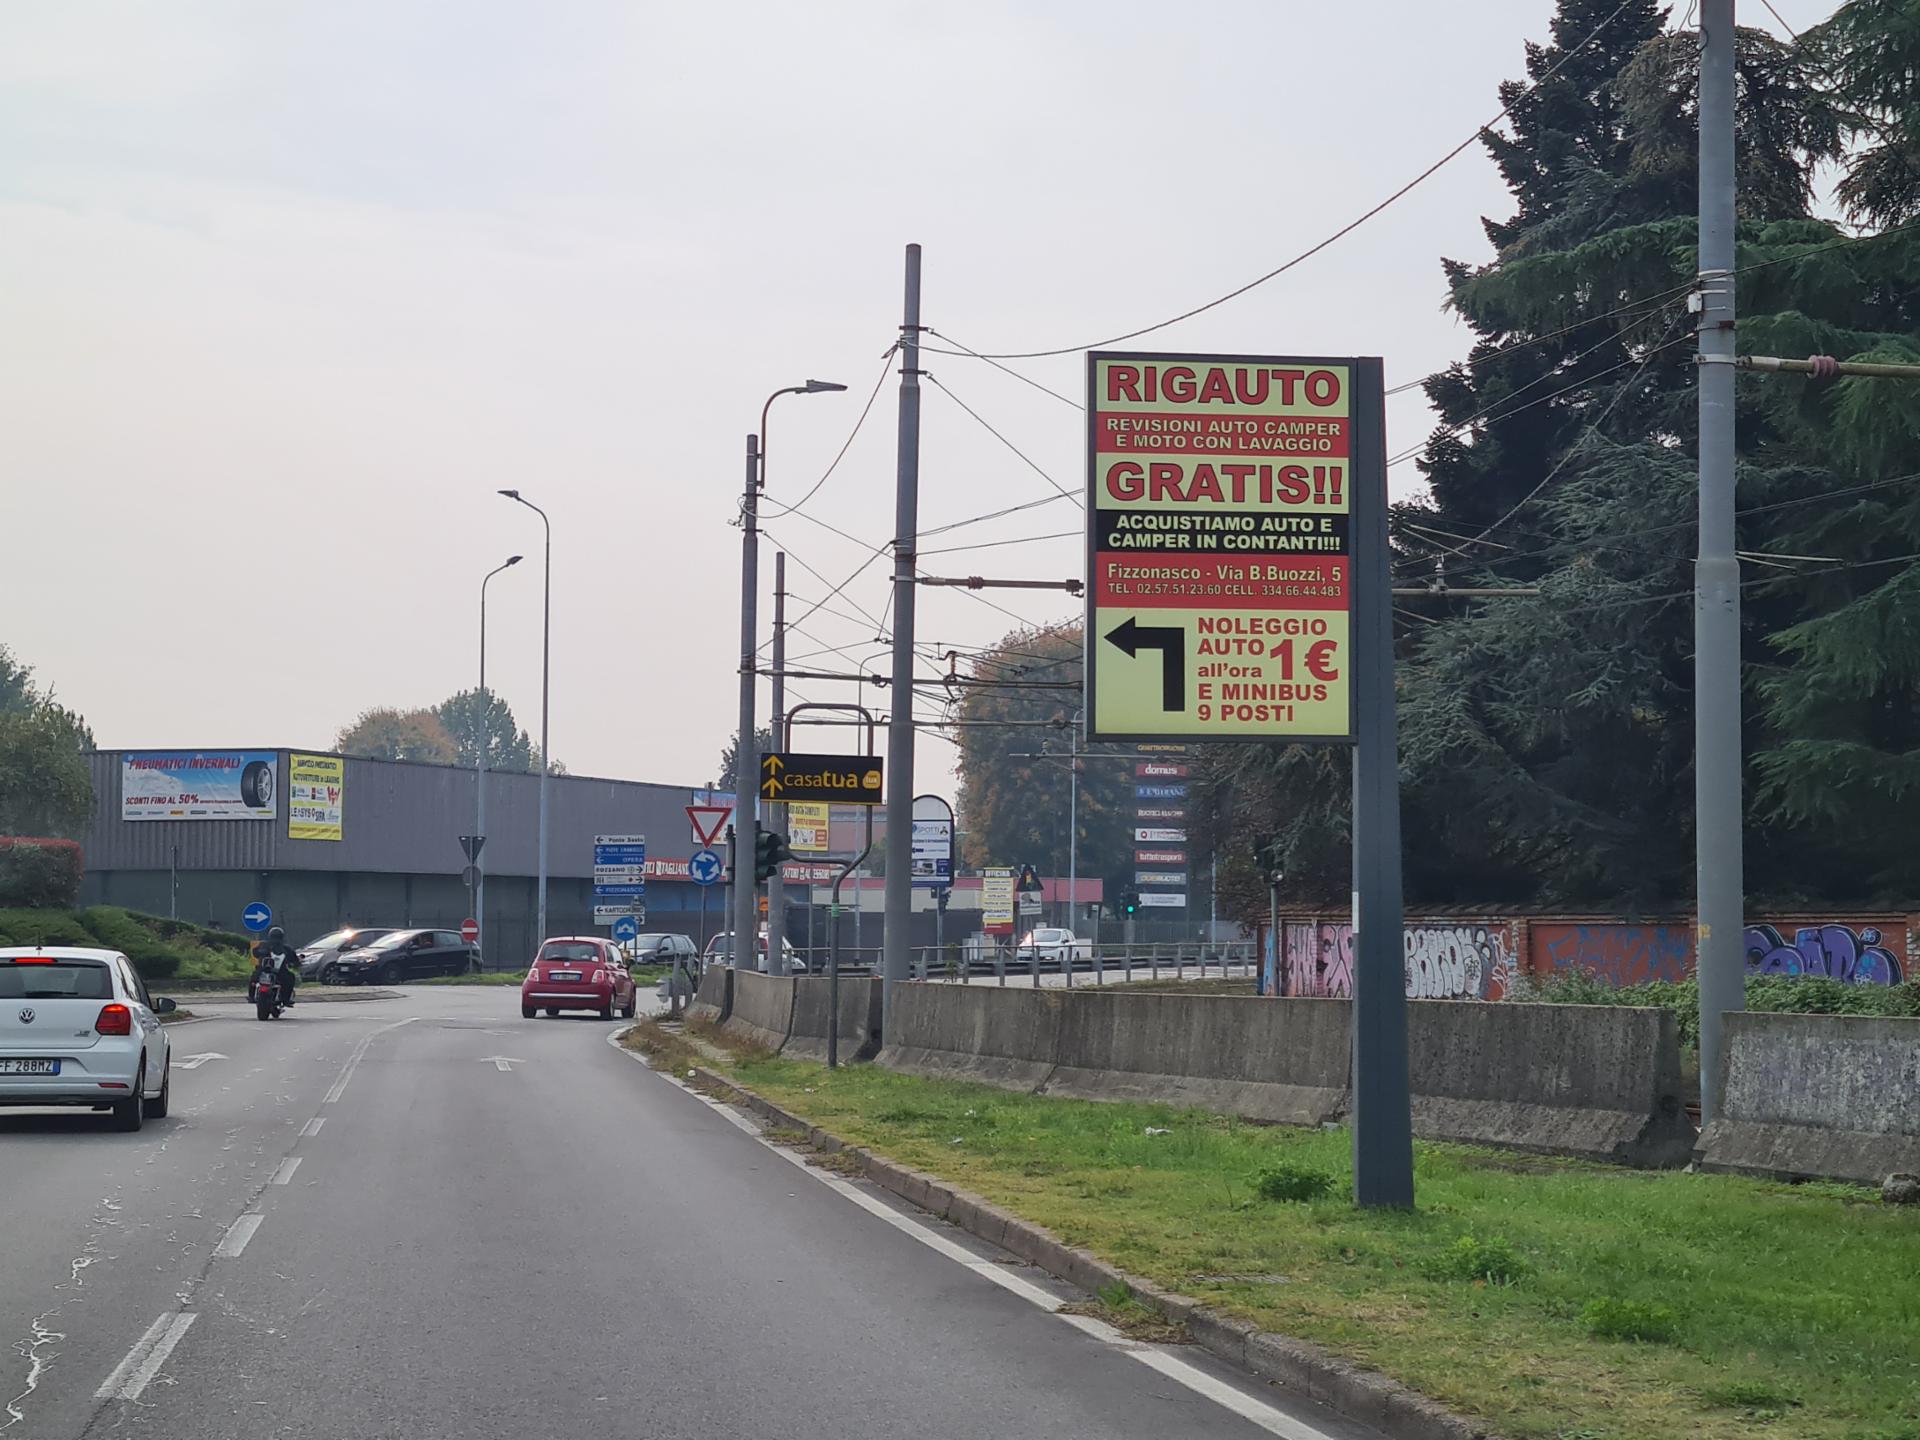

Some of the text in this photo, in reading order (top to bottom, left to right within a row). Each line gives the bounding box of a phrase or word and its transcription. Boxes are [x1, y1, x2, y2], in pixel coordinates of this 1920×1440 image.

[1107, 365, 1341, 407] RIGAUTO
[1107, 418, 1341, 437] REVISIONI AUTO CAMPER
[1116, 434, 1332, 453] E MOTO CON LAVAGGIO
[1105, 462, 1343, 505] GRATIS!!
[1116, 515, 1333, 533] ACQUISTIAMO AUTO E
[1108, 533, 1341, 551] CAMPER IN CONTANTI!!!
[1108, 563, 1201, 581] Fizzonasco
[1216, 565, 1244, 581] Via
[1249, 566, 1326, 583] B.Buozzi,
[1331, 566, 1342, 582] 5
[1108, 583, 1341, 597] TEL. 02.57.51.23.60 CELL. 334.66.44.483
[1198, 617, 1328, 636] NOLEGGIO
[1198, 638, 1339, 682] AUTO 1€
[1198, 663, 1263, 678] all'ora
[1198, 683, 1328, 701] E MINIBUS
[1198, 704, 1295, 722] 9 POSTI
[129, 757, 241, 770] PNEUMATICI INVERNALI
[1145, 763, 1178, 775] domus
[784, 770, 858, 789] casatua
[125, 797, 150, 805] SCONTI
[150, 797, 167, 805] FINO
[167, 796, 177, 804] AL
[178, 794, 199, 805] 50%
[16, 1060, 52, 1072] 288MZ
